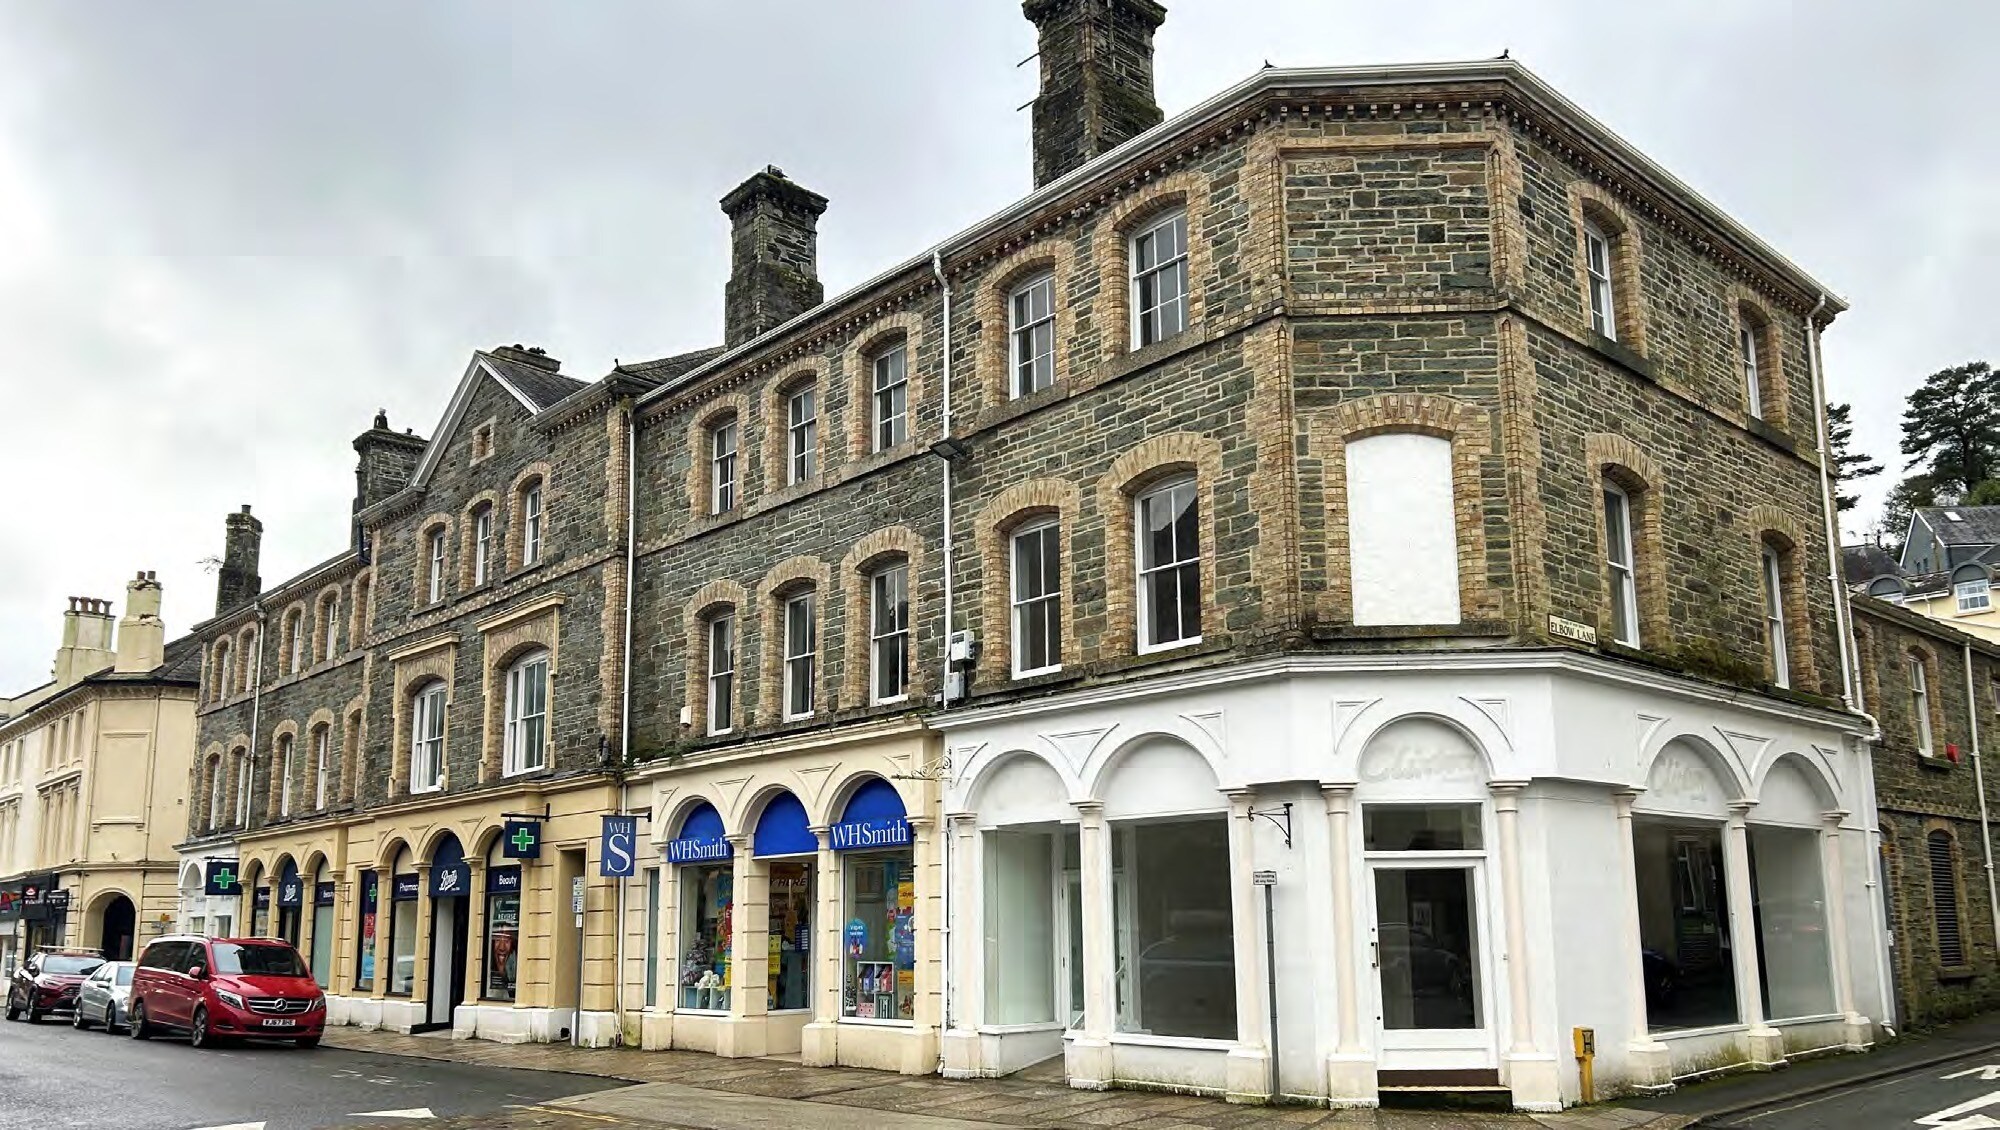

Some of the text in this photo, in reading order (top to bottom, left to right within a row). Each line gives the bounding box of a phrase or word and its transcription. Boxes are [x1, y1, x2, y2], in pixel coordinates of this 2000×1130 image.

[1551, 622, 1574, 637] ELBOW
[1577, 630, 1594, 642] LANE
[609, 822, 631, 834] WH
[832, 820, 908, 847] WHSmith
[607, 833, 631, 873] S
[669, 837, 728, 860] WHSmith
[399, 882, 419, 893] Pharmac
[498, 874, 518, 887] Beauty
